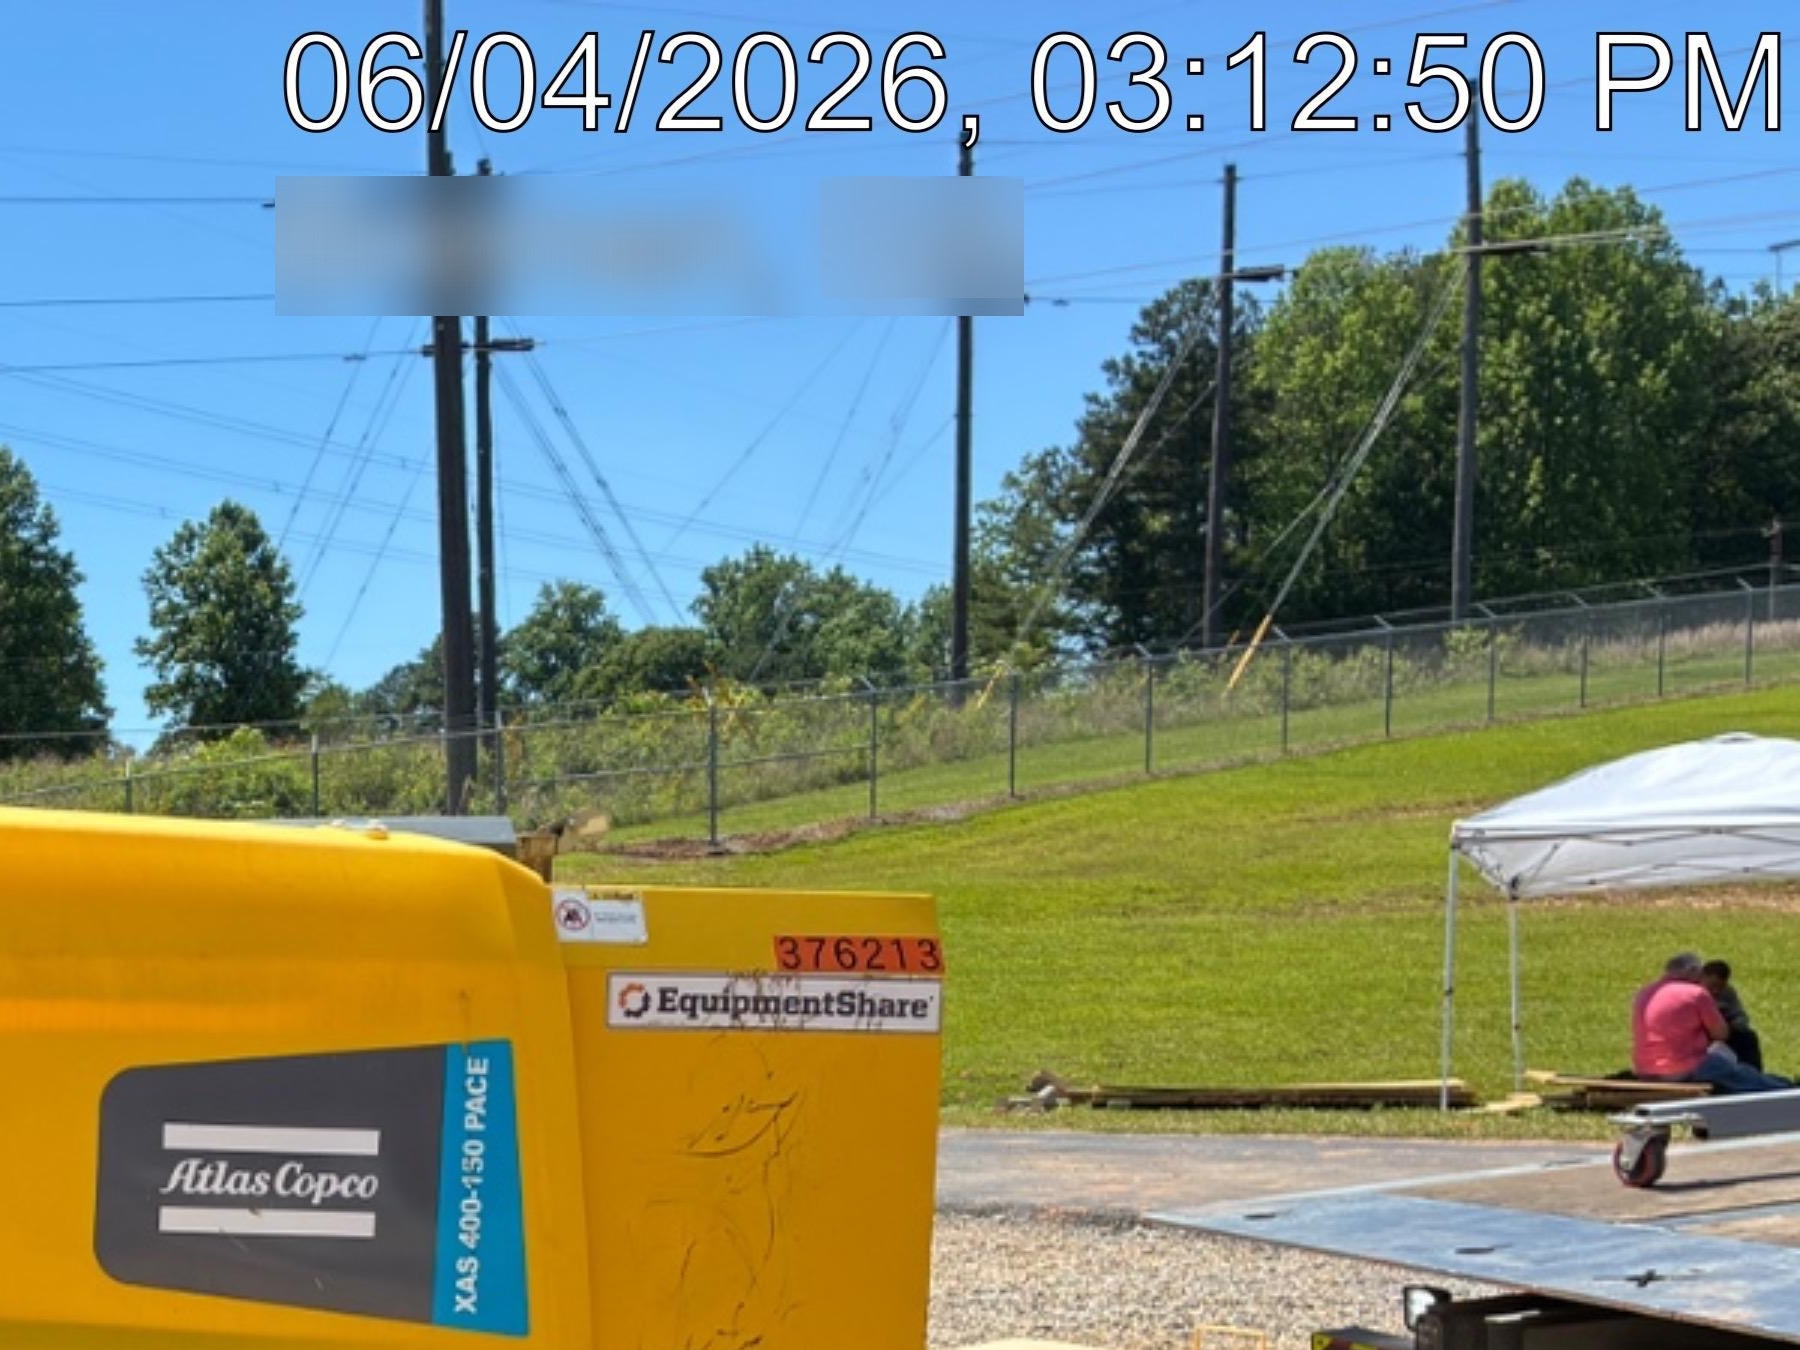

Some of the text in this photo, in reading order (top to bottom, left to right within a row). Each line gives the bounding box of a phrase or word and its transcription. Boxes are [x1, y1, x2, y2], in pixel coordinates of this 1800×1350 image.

[778, 937, 941, 971] 376213
[657, 986, 930, 1019] EquipmentShare
[159, 1157, 379, 1205] Atlas Copco
[453, 1056, 490, 1315] XAS 400-150 PACE
